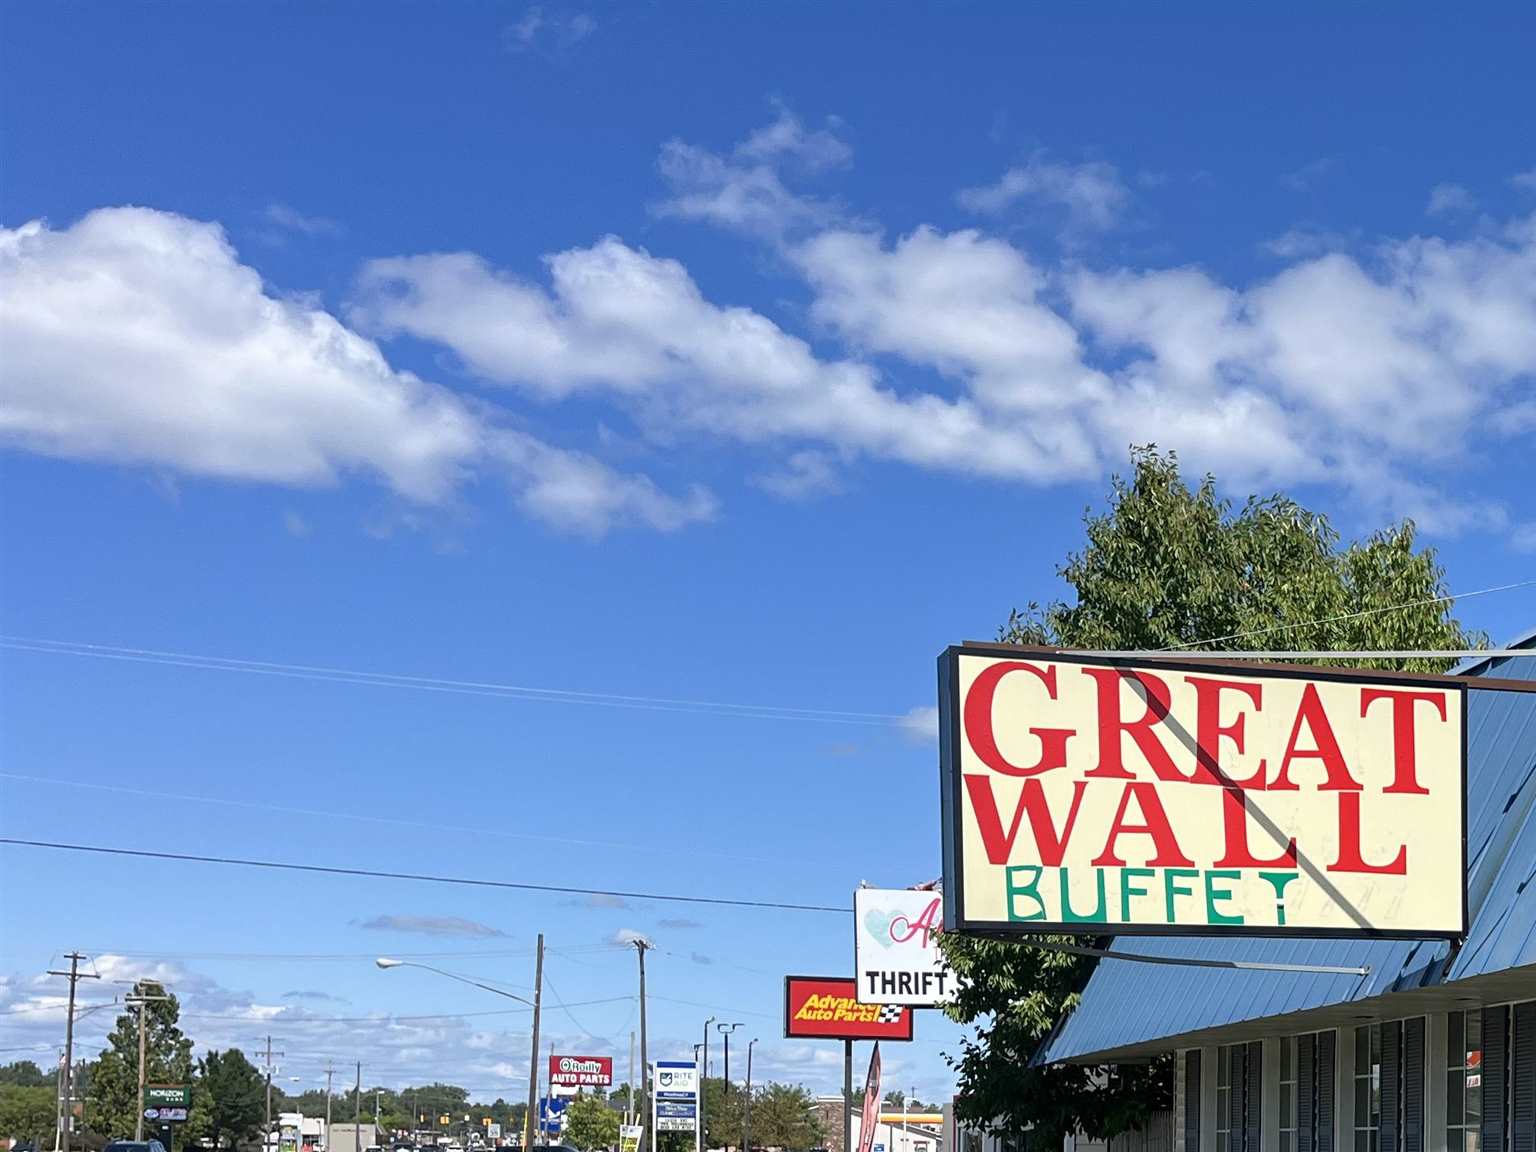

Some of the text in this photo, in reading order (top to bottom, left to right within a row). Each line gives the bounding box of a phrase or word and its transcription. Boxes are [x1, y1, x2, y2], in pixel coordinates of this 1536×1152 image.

[963, 661, 1448, 795] GREAT
[963, 773, 1408, 876] WALL
[1004, 864, 1300, 926] BUFFET
[865, 970, 948, 996] THRIFT
[793, 1007, 874, 1022] Auto Parts
[560, 1058, 602, 1073] O'Reilly
[551, 1073, 610, 1084] AUTO PARTS
[673, 1071, 693, 1080] RITE
[150, 1089, 184, 1097] HORIZON
